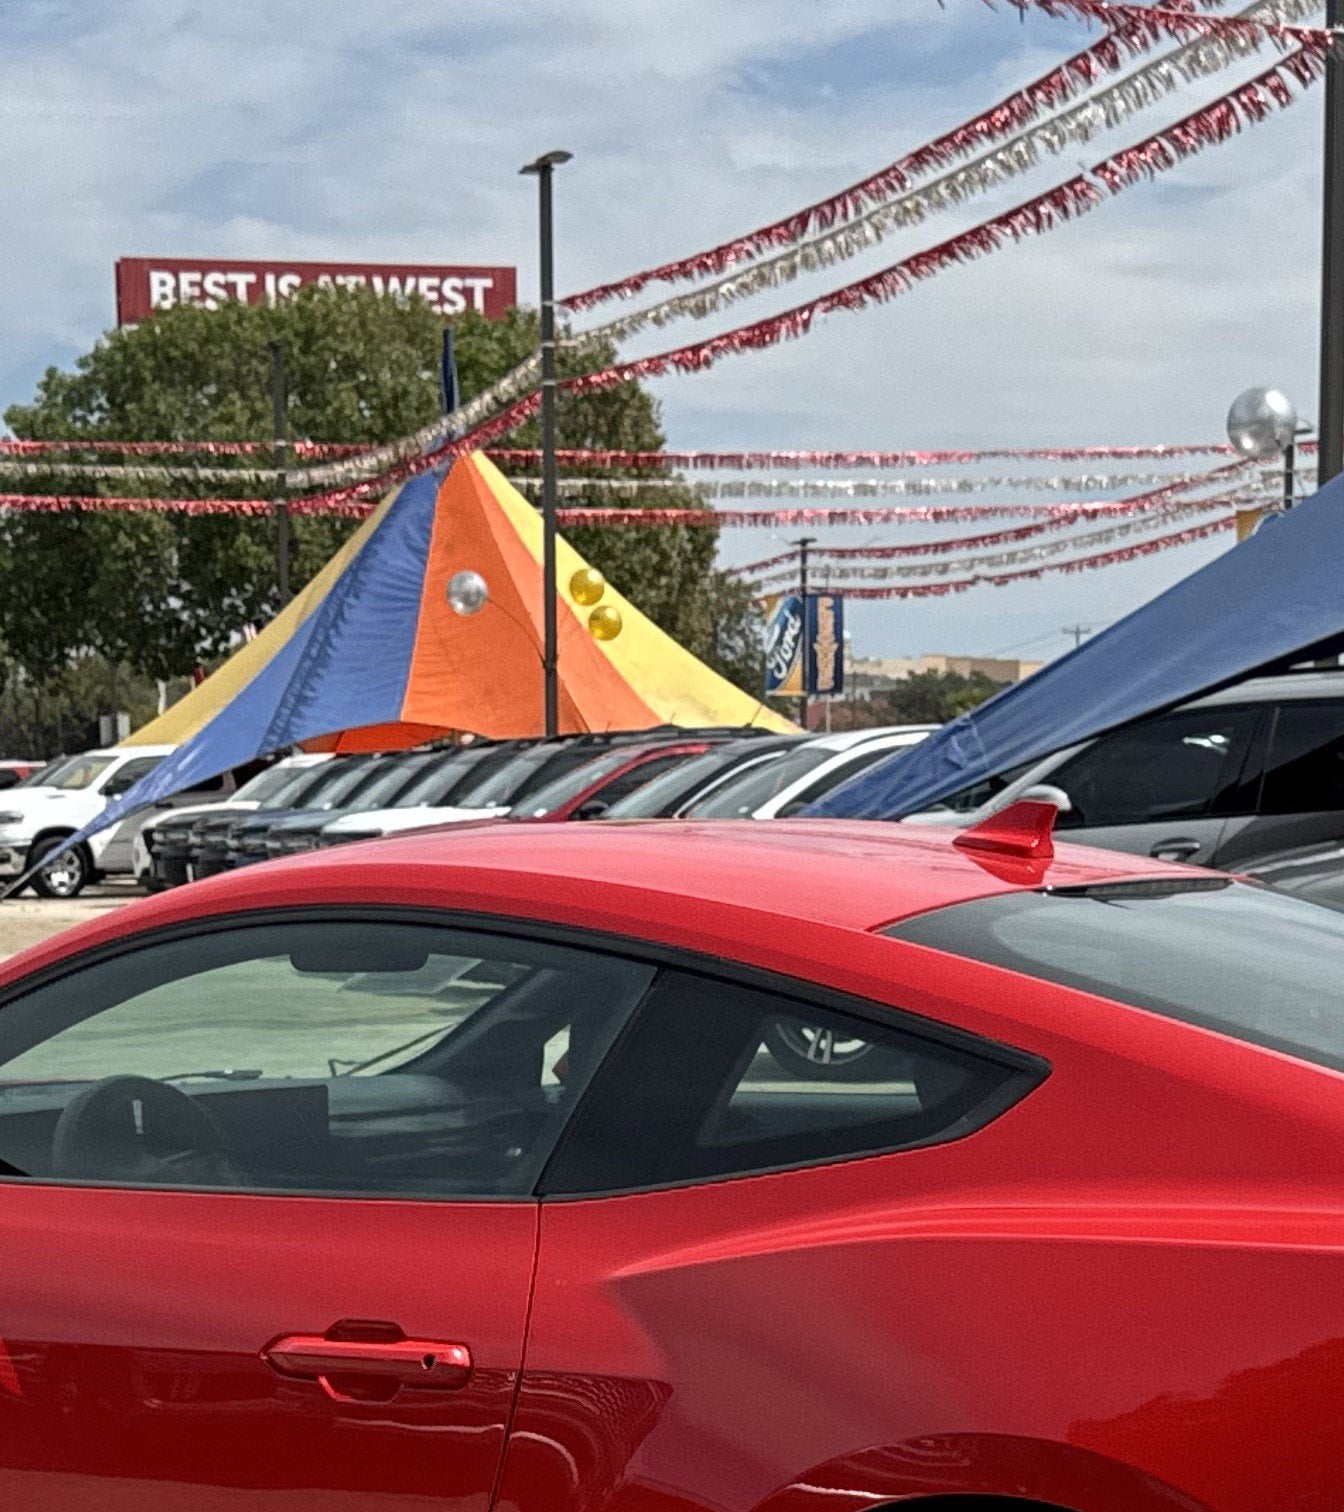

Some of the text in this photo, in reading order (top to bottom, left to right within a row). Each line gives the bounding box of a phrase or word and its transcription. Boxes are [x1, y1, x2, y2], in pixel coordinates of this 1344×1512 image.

[149, 271, 258, 311] BEST
[371, 274, 494, 315] WEST
[765, 610, 802, 679] Ford
